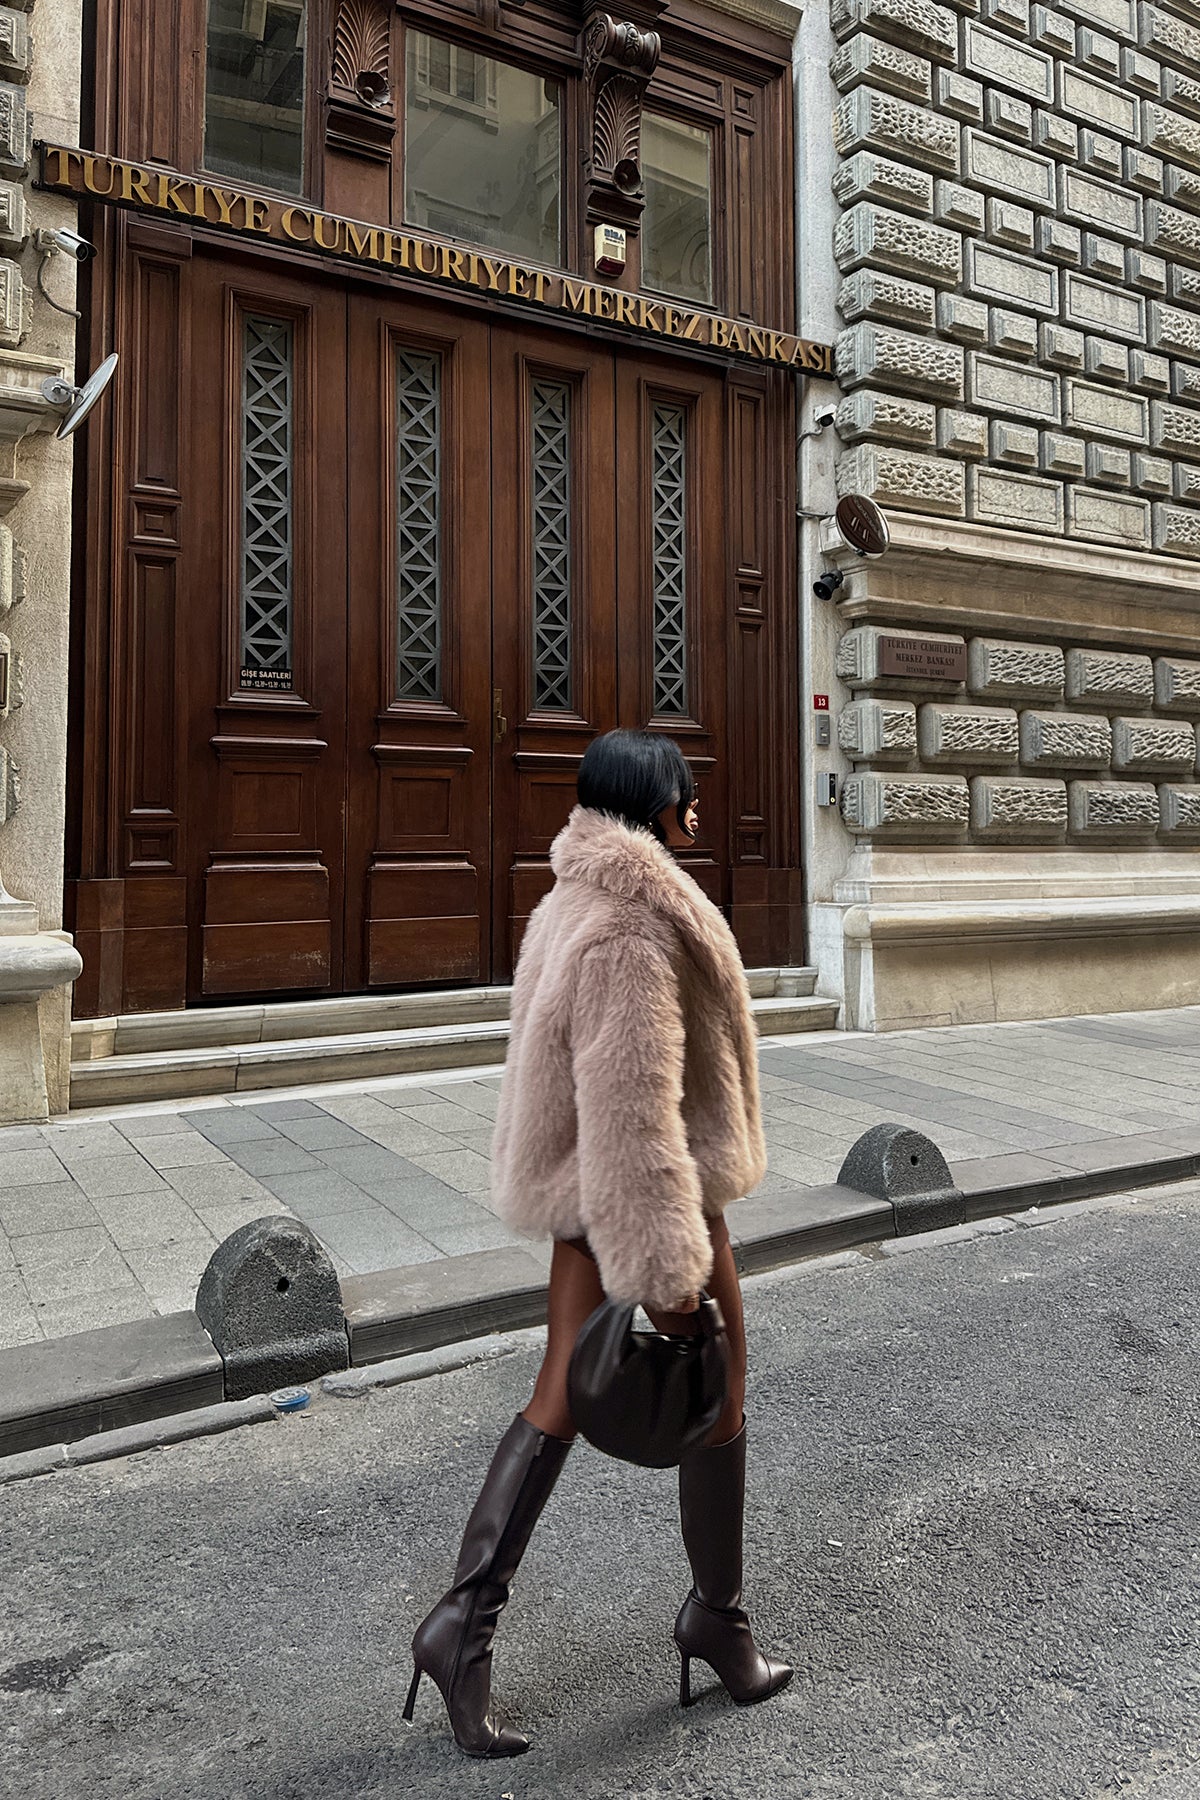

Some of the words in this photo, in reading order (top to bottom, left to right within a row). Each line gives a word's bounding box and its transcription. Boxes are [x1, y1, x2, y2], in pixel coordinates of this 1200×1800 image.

[561, 278, 703, 342] MERKEZ
[709, 317, 834, 374] BANKASI
[241, 669, 258, 679] GİŞE
[258, 670, 292, 680] SAATLERİ
[818, 698, 826, 706] 13
